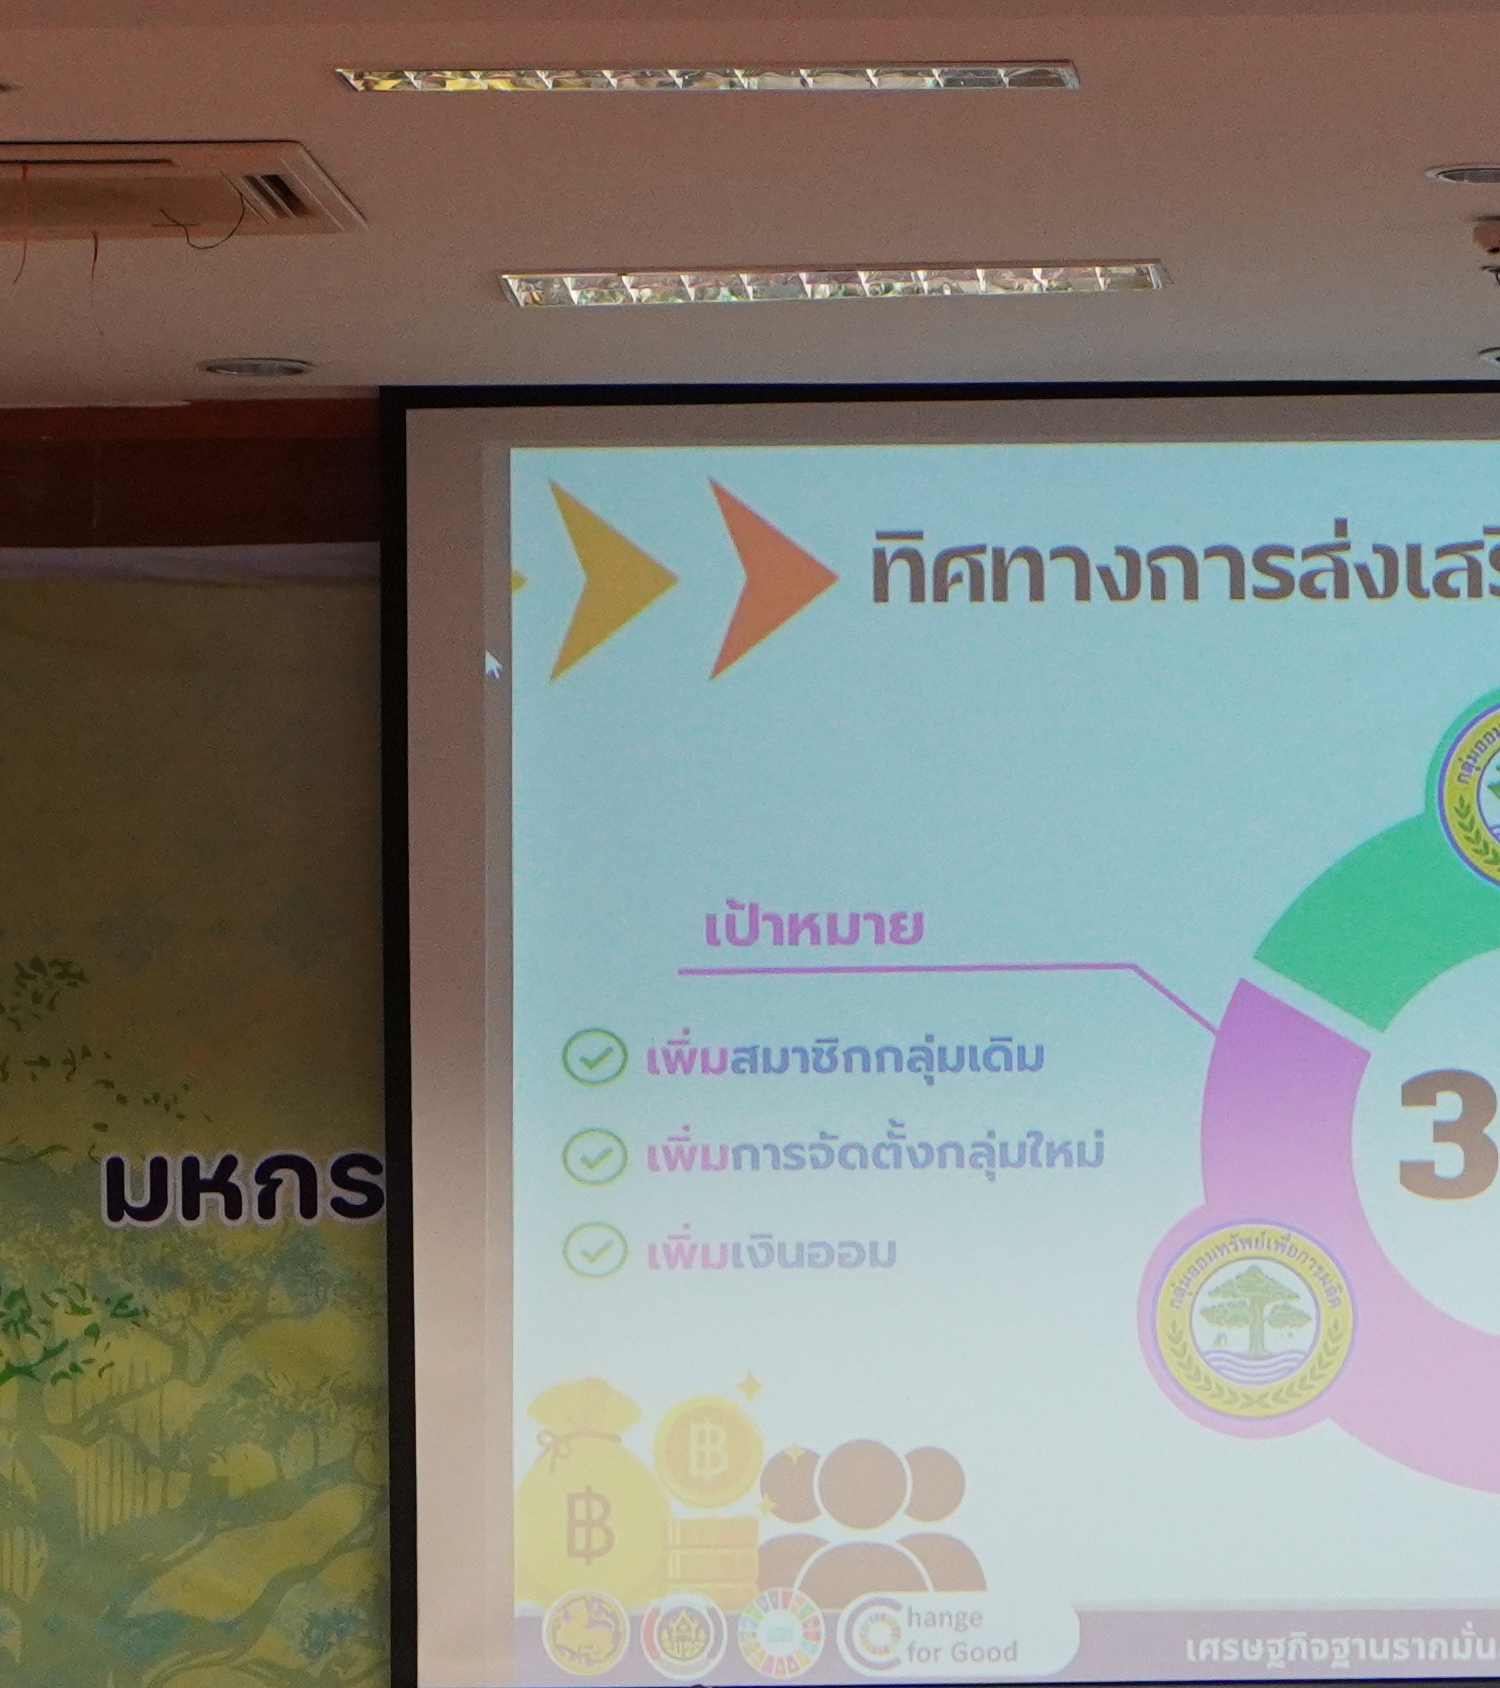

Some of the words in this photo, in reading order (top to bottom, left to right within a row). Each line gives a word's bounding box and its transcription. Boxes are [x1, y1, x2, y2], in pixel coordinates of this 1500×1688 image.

[705, 898, 924, 947] เป้าหมาย
[647, 1027, 1045, 1087] เพิ่มสมาชิกกลุ่มเดิม
[647, 1118, 1104, 1182] เพิ่มการจัดตั้งกลุ่มใหม่
[647, 1223, 896, 1270] เพิ่มเงินออม
[907, 1641, 941, 1664] for
[950, 1641, 1018, 1664] Good
